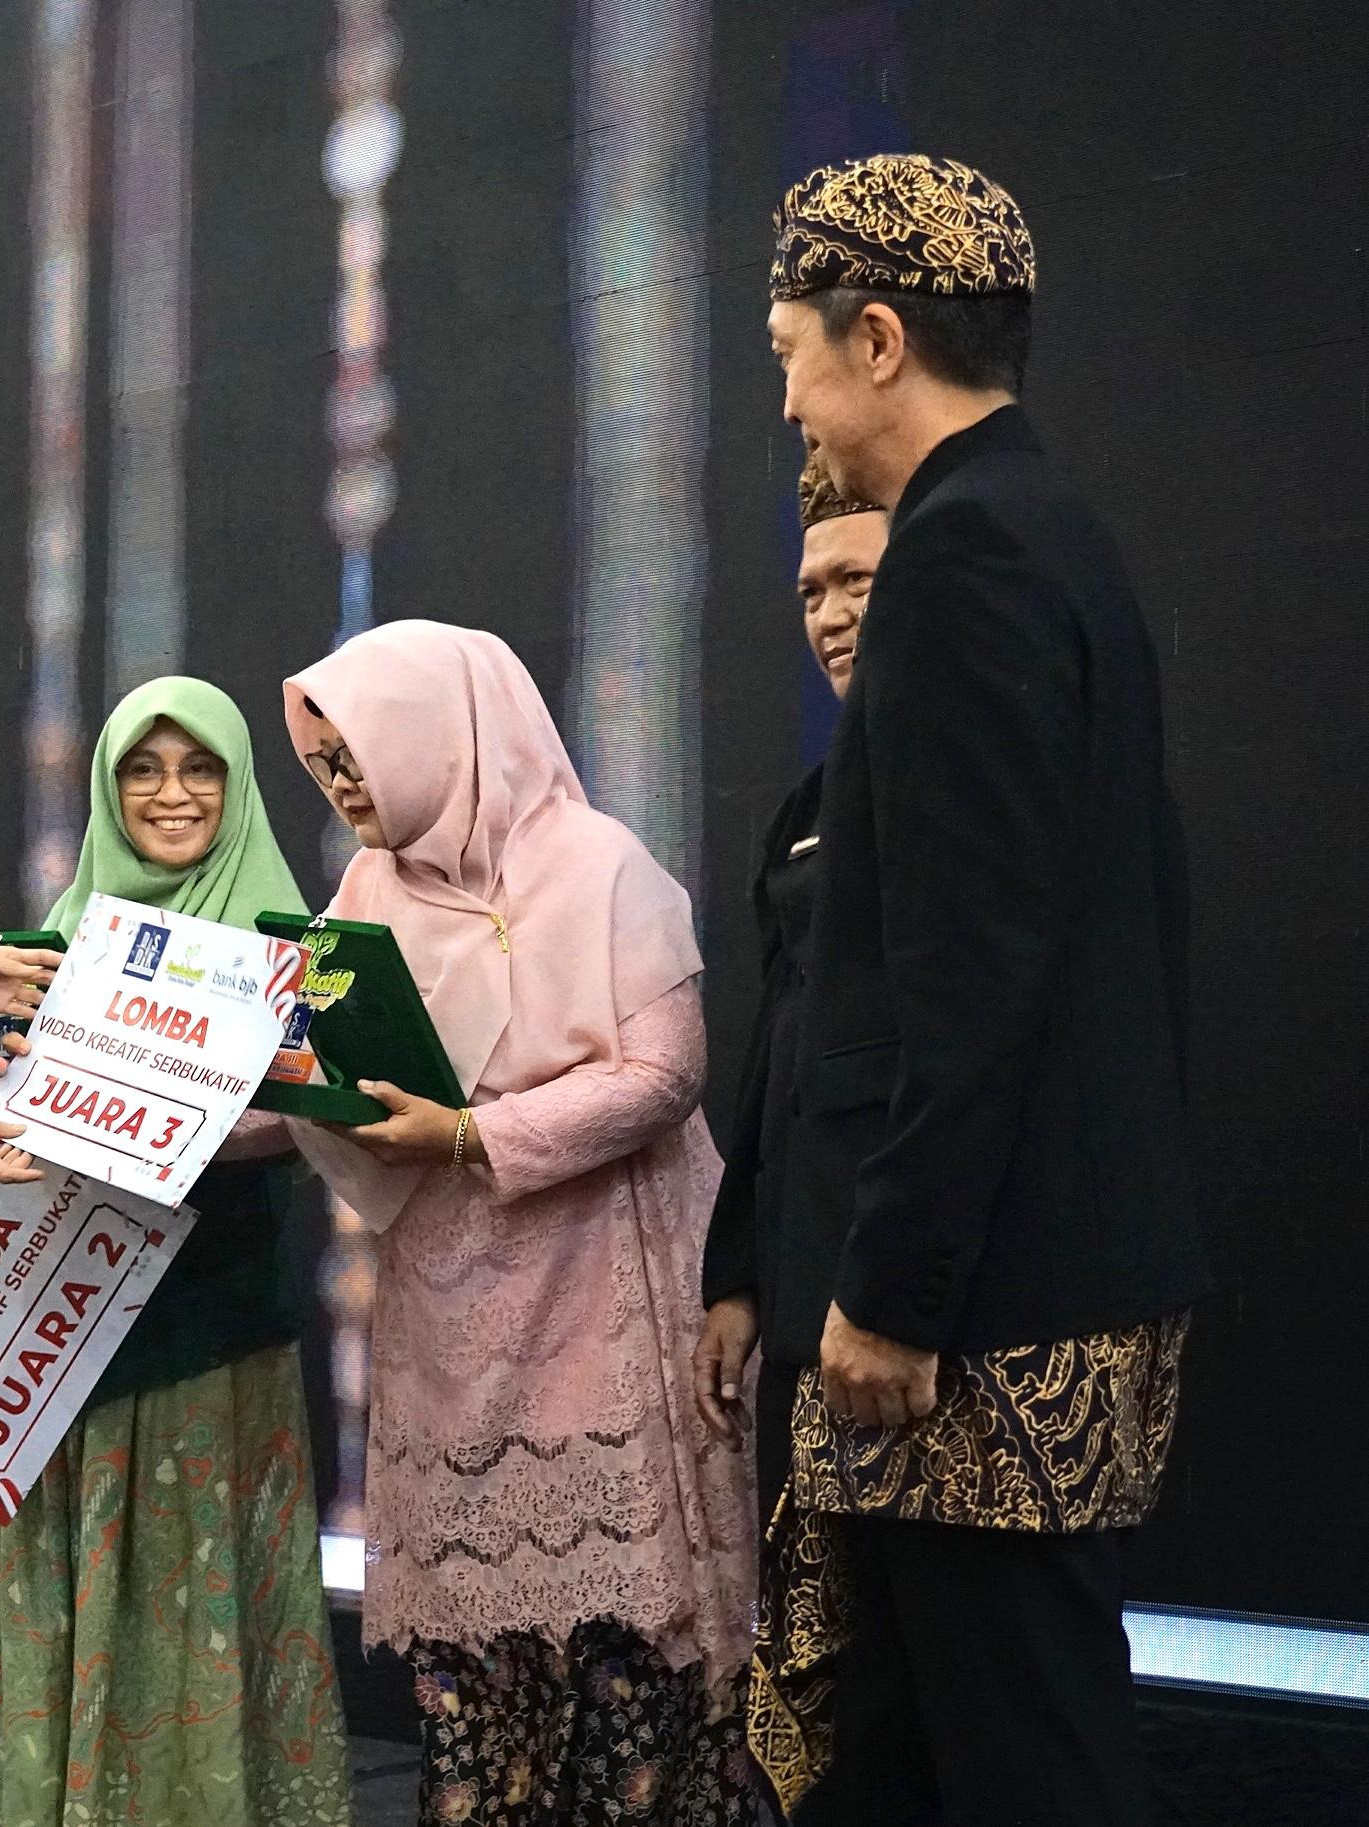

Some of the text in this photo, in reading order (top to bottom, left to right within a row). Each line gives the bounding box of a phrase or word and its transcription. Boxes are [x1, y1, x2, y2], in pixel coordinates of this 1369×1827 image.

[212, 968, 236, 991] bank
[103, 990, 210, 1049] LOMBA
[39, 1014, 251, 1097] VIDEO KREATIF SERBUKATIF
[29, 1074, 184, 1150] JUARA 3
[88, 1231, 128, 1268] 2
